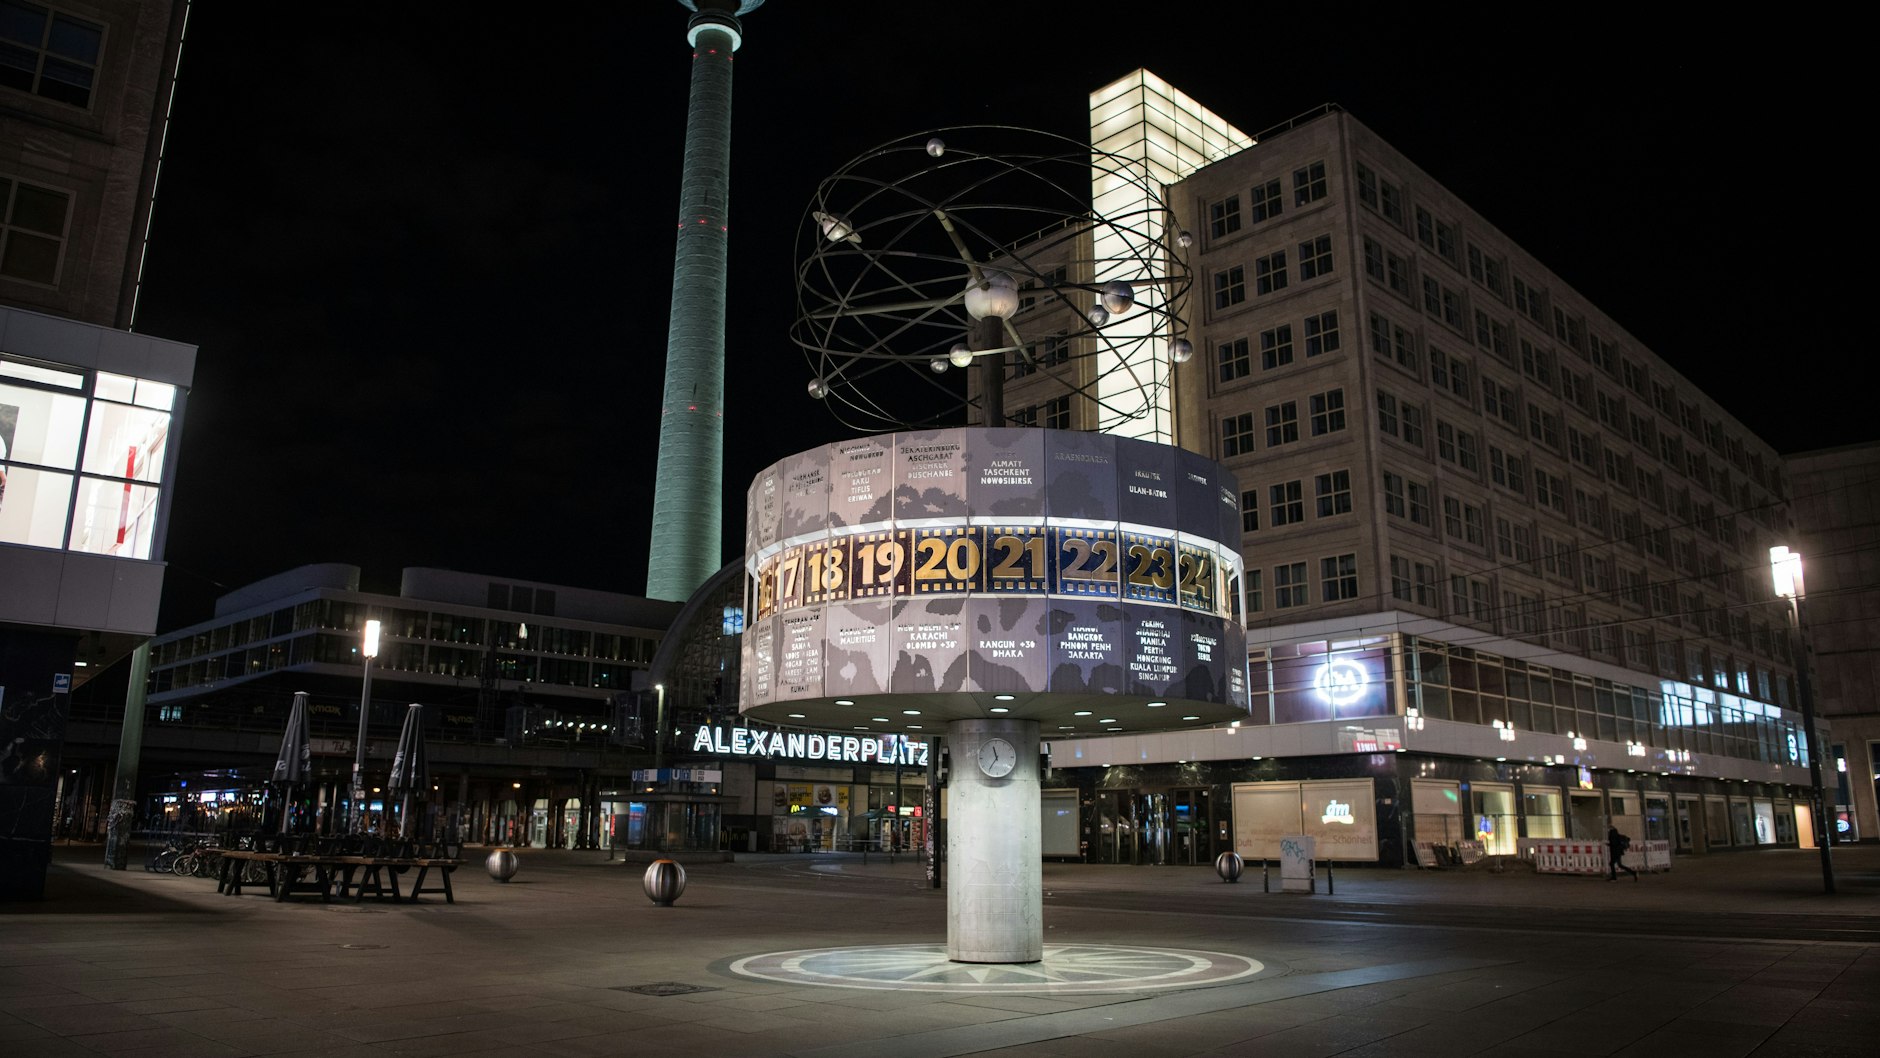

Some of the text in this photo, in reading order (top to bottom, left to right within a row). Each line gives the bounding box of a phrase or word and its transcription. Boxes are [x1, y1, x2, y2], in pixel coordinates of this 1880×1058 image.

[908, 453, 953, 462] ASCHGABAT
[908, 470, 953, 479] DUSCHANBE
[983, 468, 1030, 476] TASCHKENT
[852, 478, 870, 487] BAKU
[980, 477, 1033, 485] NOWOSIBIRSK
[850, 485, 871, 494] TIFLIS
[1129, 485, 1167, 498] ULAN-BATOR
[848, 493, 873, 503] ERIWAN
[775, 557, 801, 600] 17
[808, 549, 843, 592] 18
[858, 542, 905, 584] 19
[916, 537, 980, 579] 20
[993, 536, 1046, 578] 21
[1062, 538, 1119, 582] 22
[1129, 545, 1174, 589] 23
[1179, 554, 1211, 599] 24
[840, 634, 876, 645] MAURITIUS
[910, 631, 948, 640] KARACHI
[1067, 632, 1104, 642] BANGKOK
[979, 640, 1015, 648] RANGUN
[1060, 641, 1112, 651] PHNOM PENH
[1140, 636, 1166, 646] MANILA
[992, 650, 1024, 658] DHAKA
[1143, 645, 1164, 655] PERTH
[1068, 651, 1104, 660] JAKARTA
[1136, 654, 1172, 664] HONGKONG
[1130, 662, 1152, 672] KUALA
[693, 725, 928, 766] ALEXANDERPLATZ
[1325, 800, 1350, 816] dm
